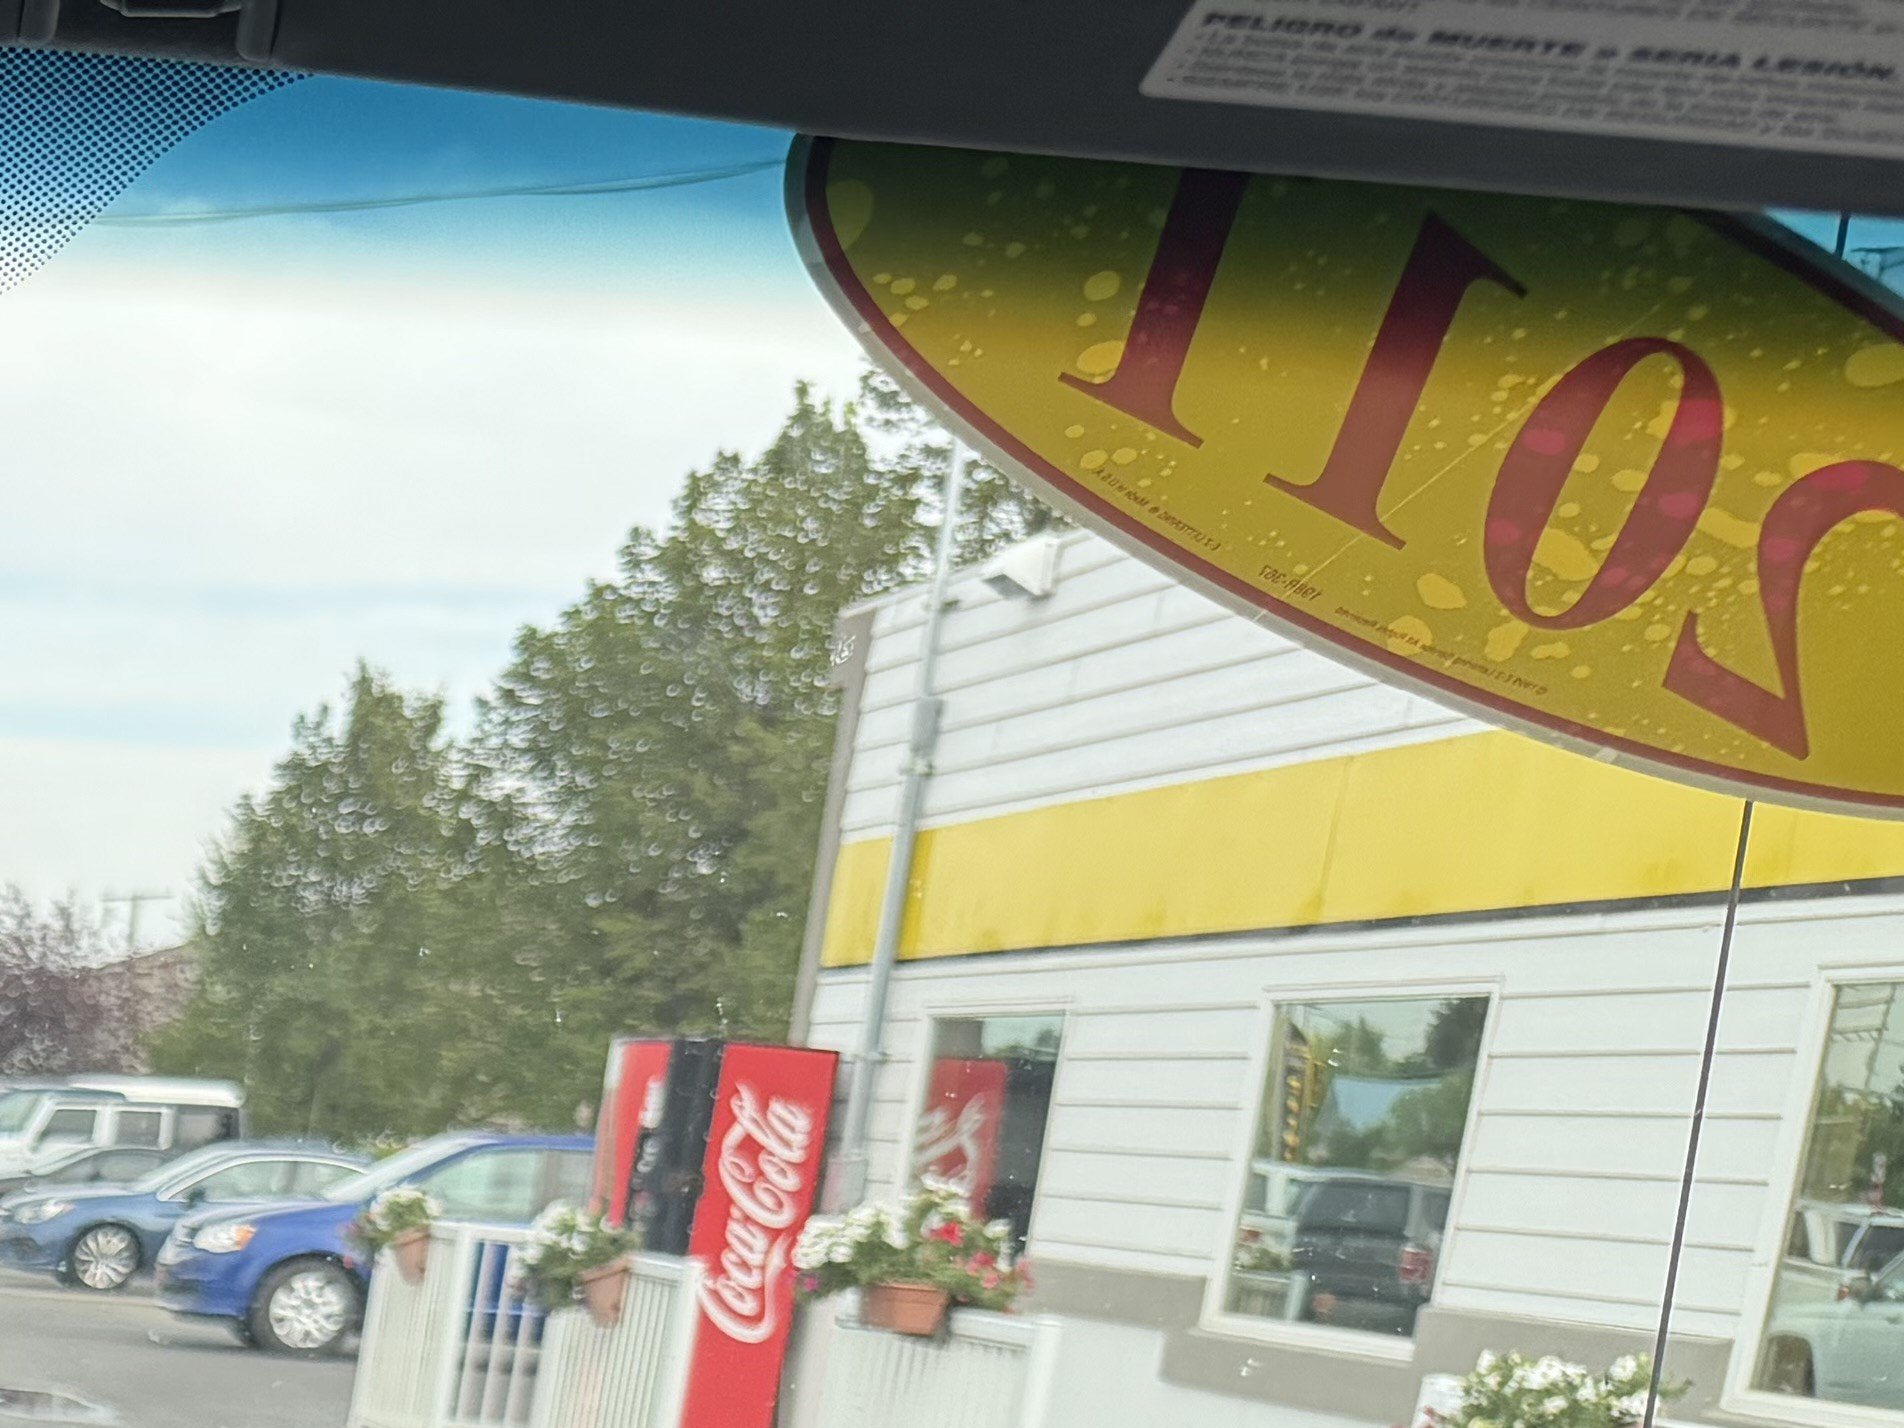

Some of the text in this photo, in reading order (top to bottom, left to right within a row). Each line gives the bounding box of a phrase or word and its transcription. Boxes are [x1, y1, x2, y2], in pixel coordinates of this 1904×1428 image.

[1202, 9, 1365, 40] PELIGRO
[1426, 29, 1587, 59] MUERTE
[1630, 45, 1741, 72] SERIA
[1752, 54, 1897, 83] LESIÓN
[696, 1079, 814, 1344] Coca-Cola
